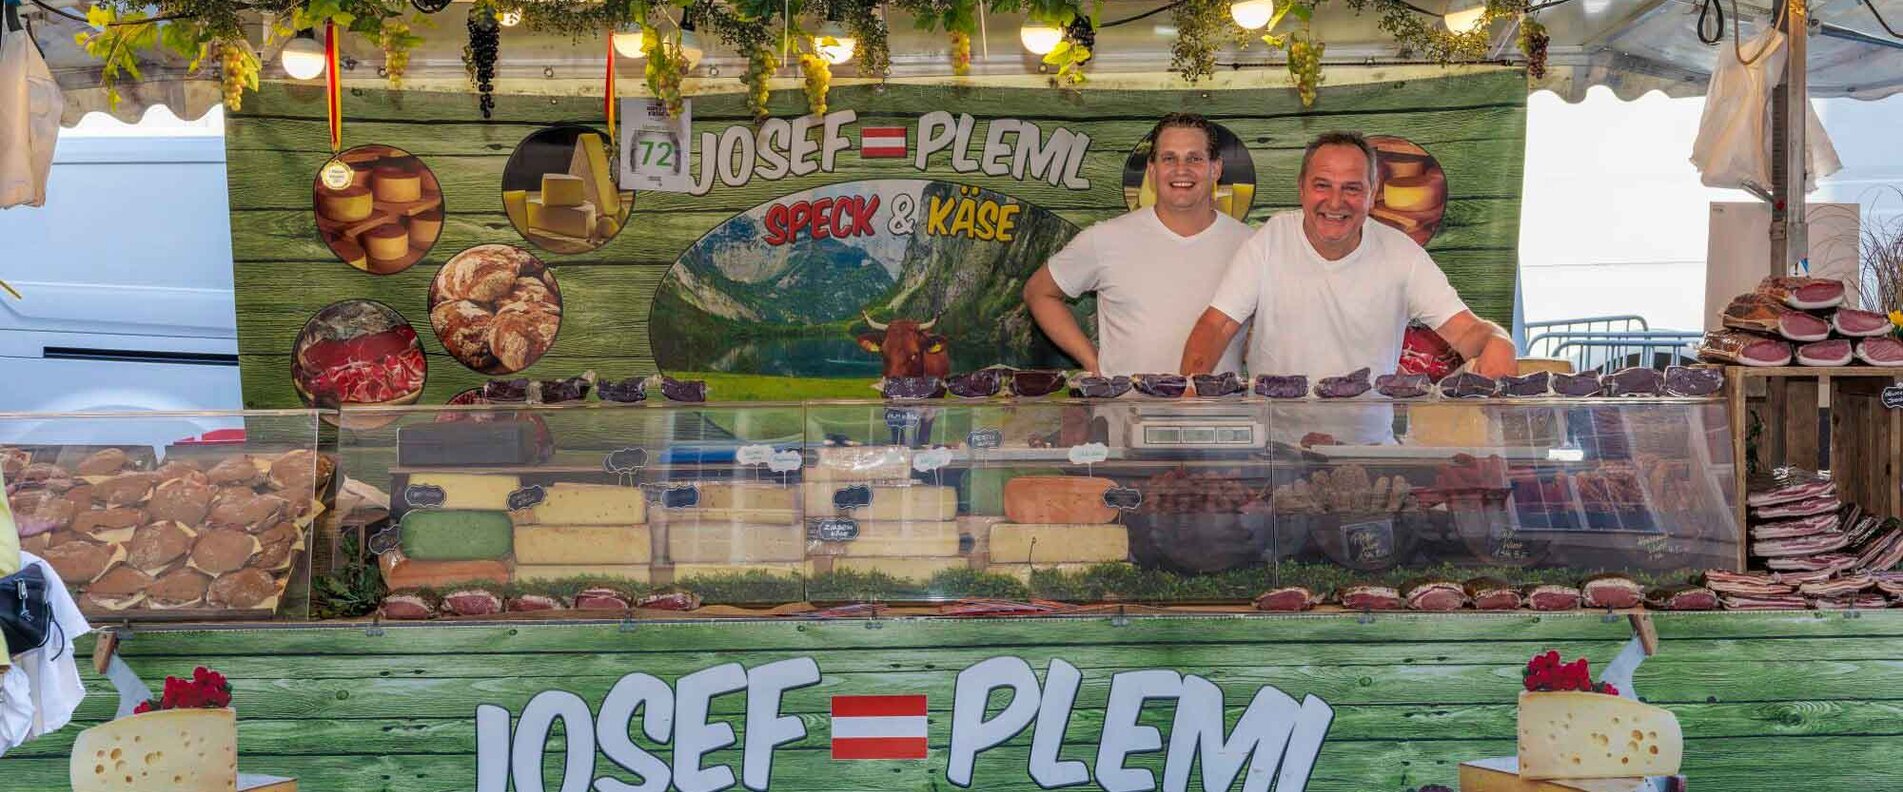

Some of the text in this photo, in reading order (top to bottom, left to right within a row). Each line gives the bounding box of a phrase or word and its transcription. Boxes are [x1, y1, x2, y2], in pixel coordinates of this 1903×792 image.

[638, 140, 674, 167] 72
[687, 109, 1093, 197] JOSEF PLEML
[764, 184, 1021, 246] SPECK & KÄSE
